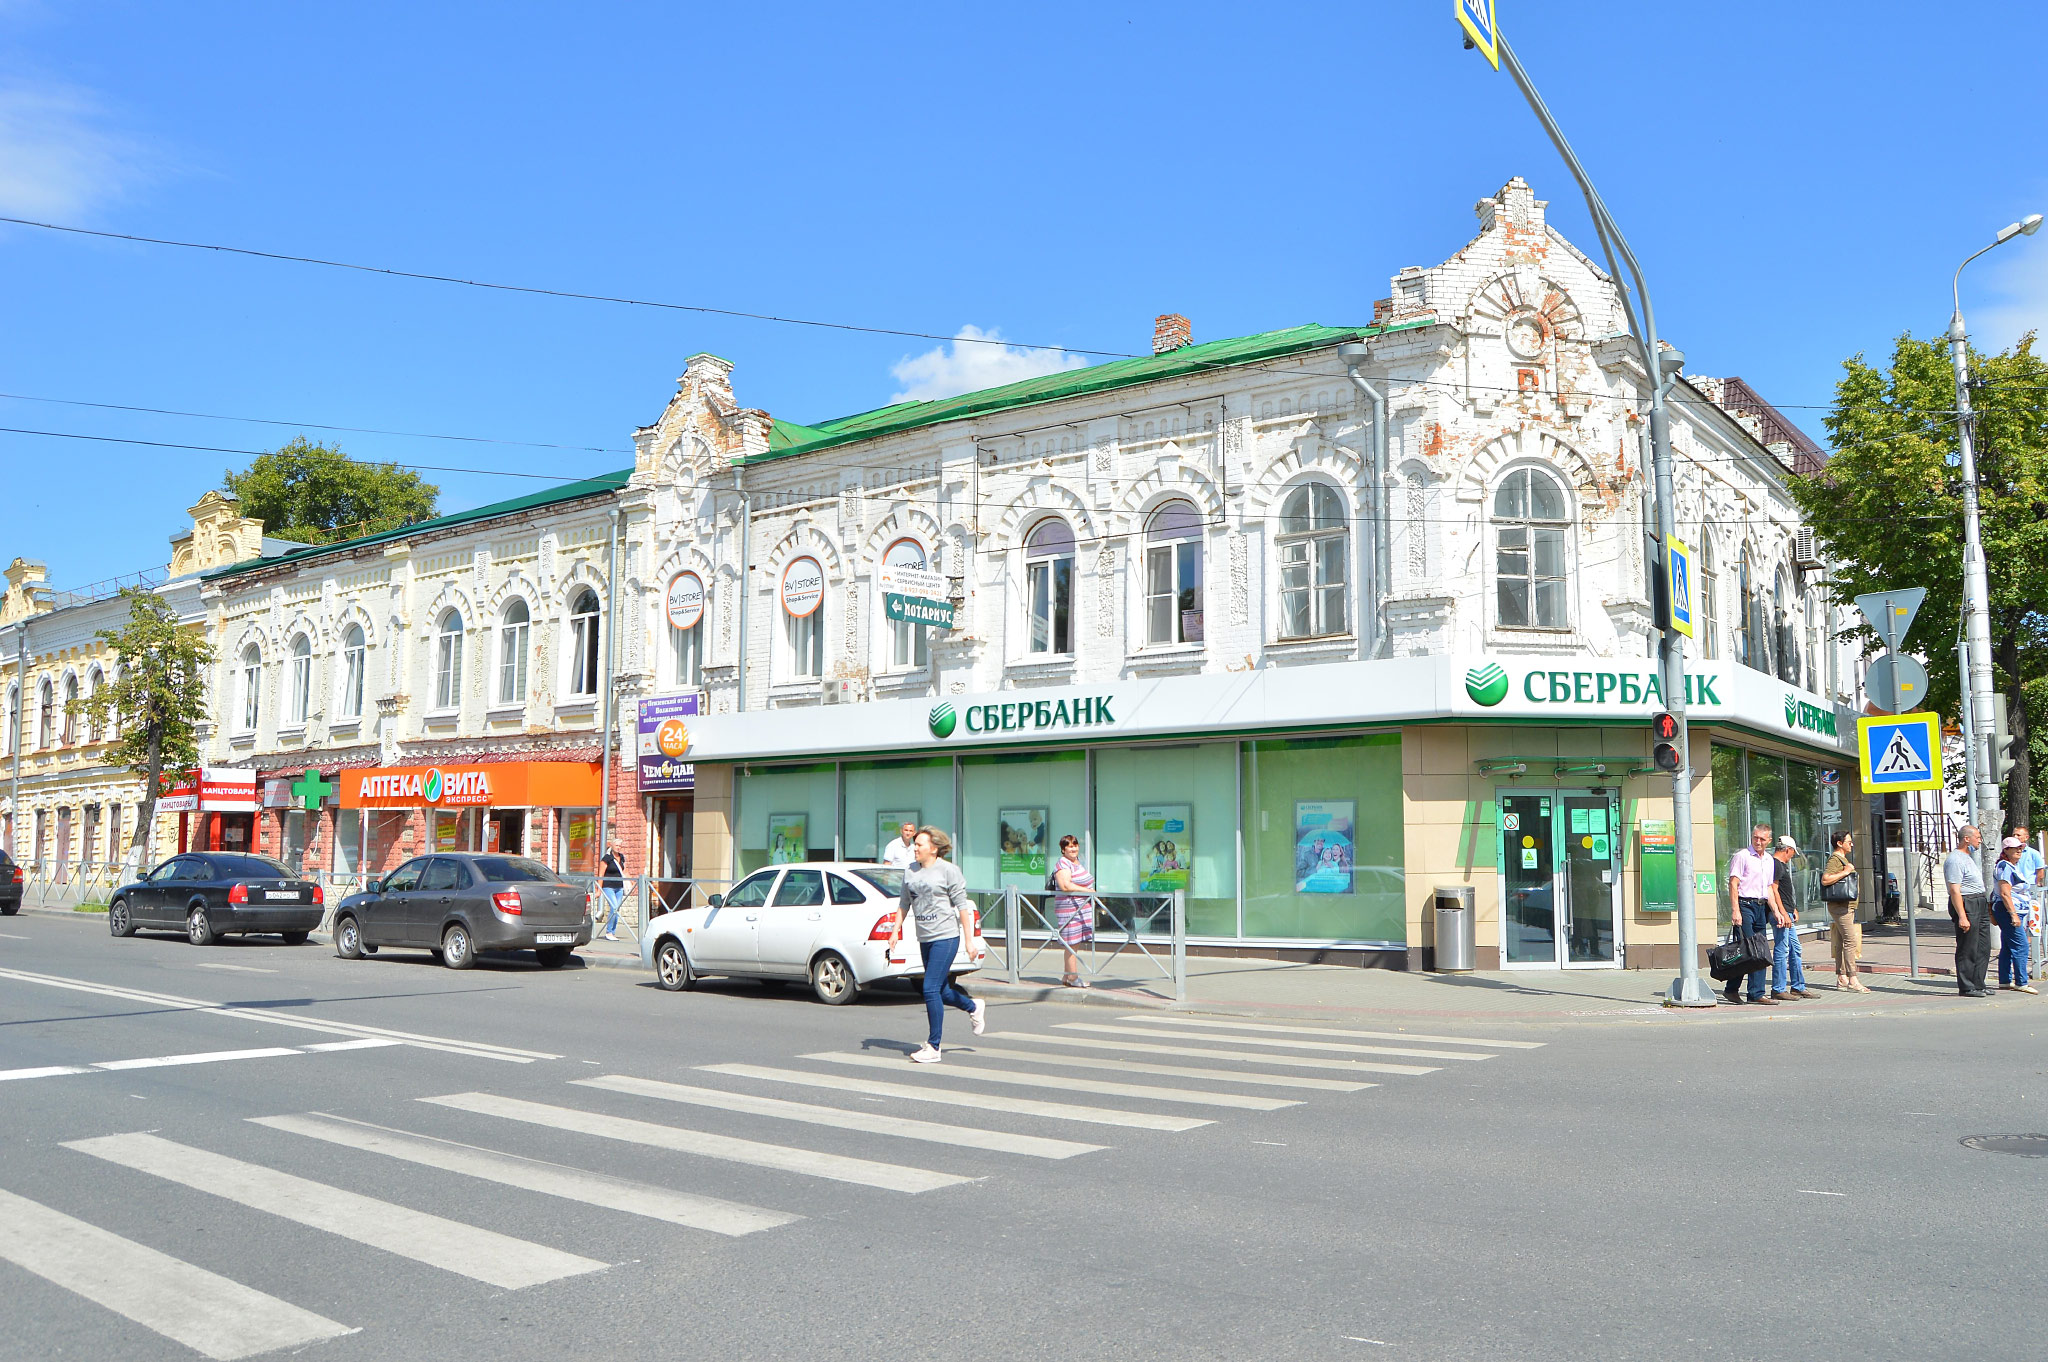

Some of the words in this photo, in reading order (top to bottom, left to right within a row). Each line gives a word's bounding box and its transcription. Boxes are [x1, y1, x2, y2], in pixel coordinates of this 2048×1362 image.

[904, 602, 952, 623] НОТАРИУС
[965, 695, 1116, 733] СБЕРБАНК
[663, 727, 683, 742] 24
[664, 742, 683, 750] ЧАСА
[359, 774, 423, 797] АПТЕКА
[443, 771, 490, 796] ВИТА
[202, 787, 255, 795] КАНЦТОВАРЫ
[161, 800, 193, 810] КАНЦТОВАРЫ
[445, 795, 489, 804] ЭКСПРЕСС
